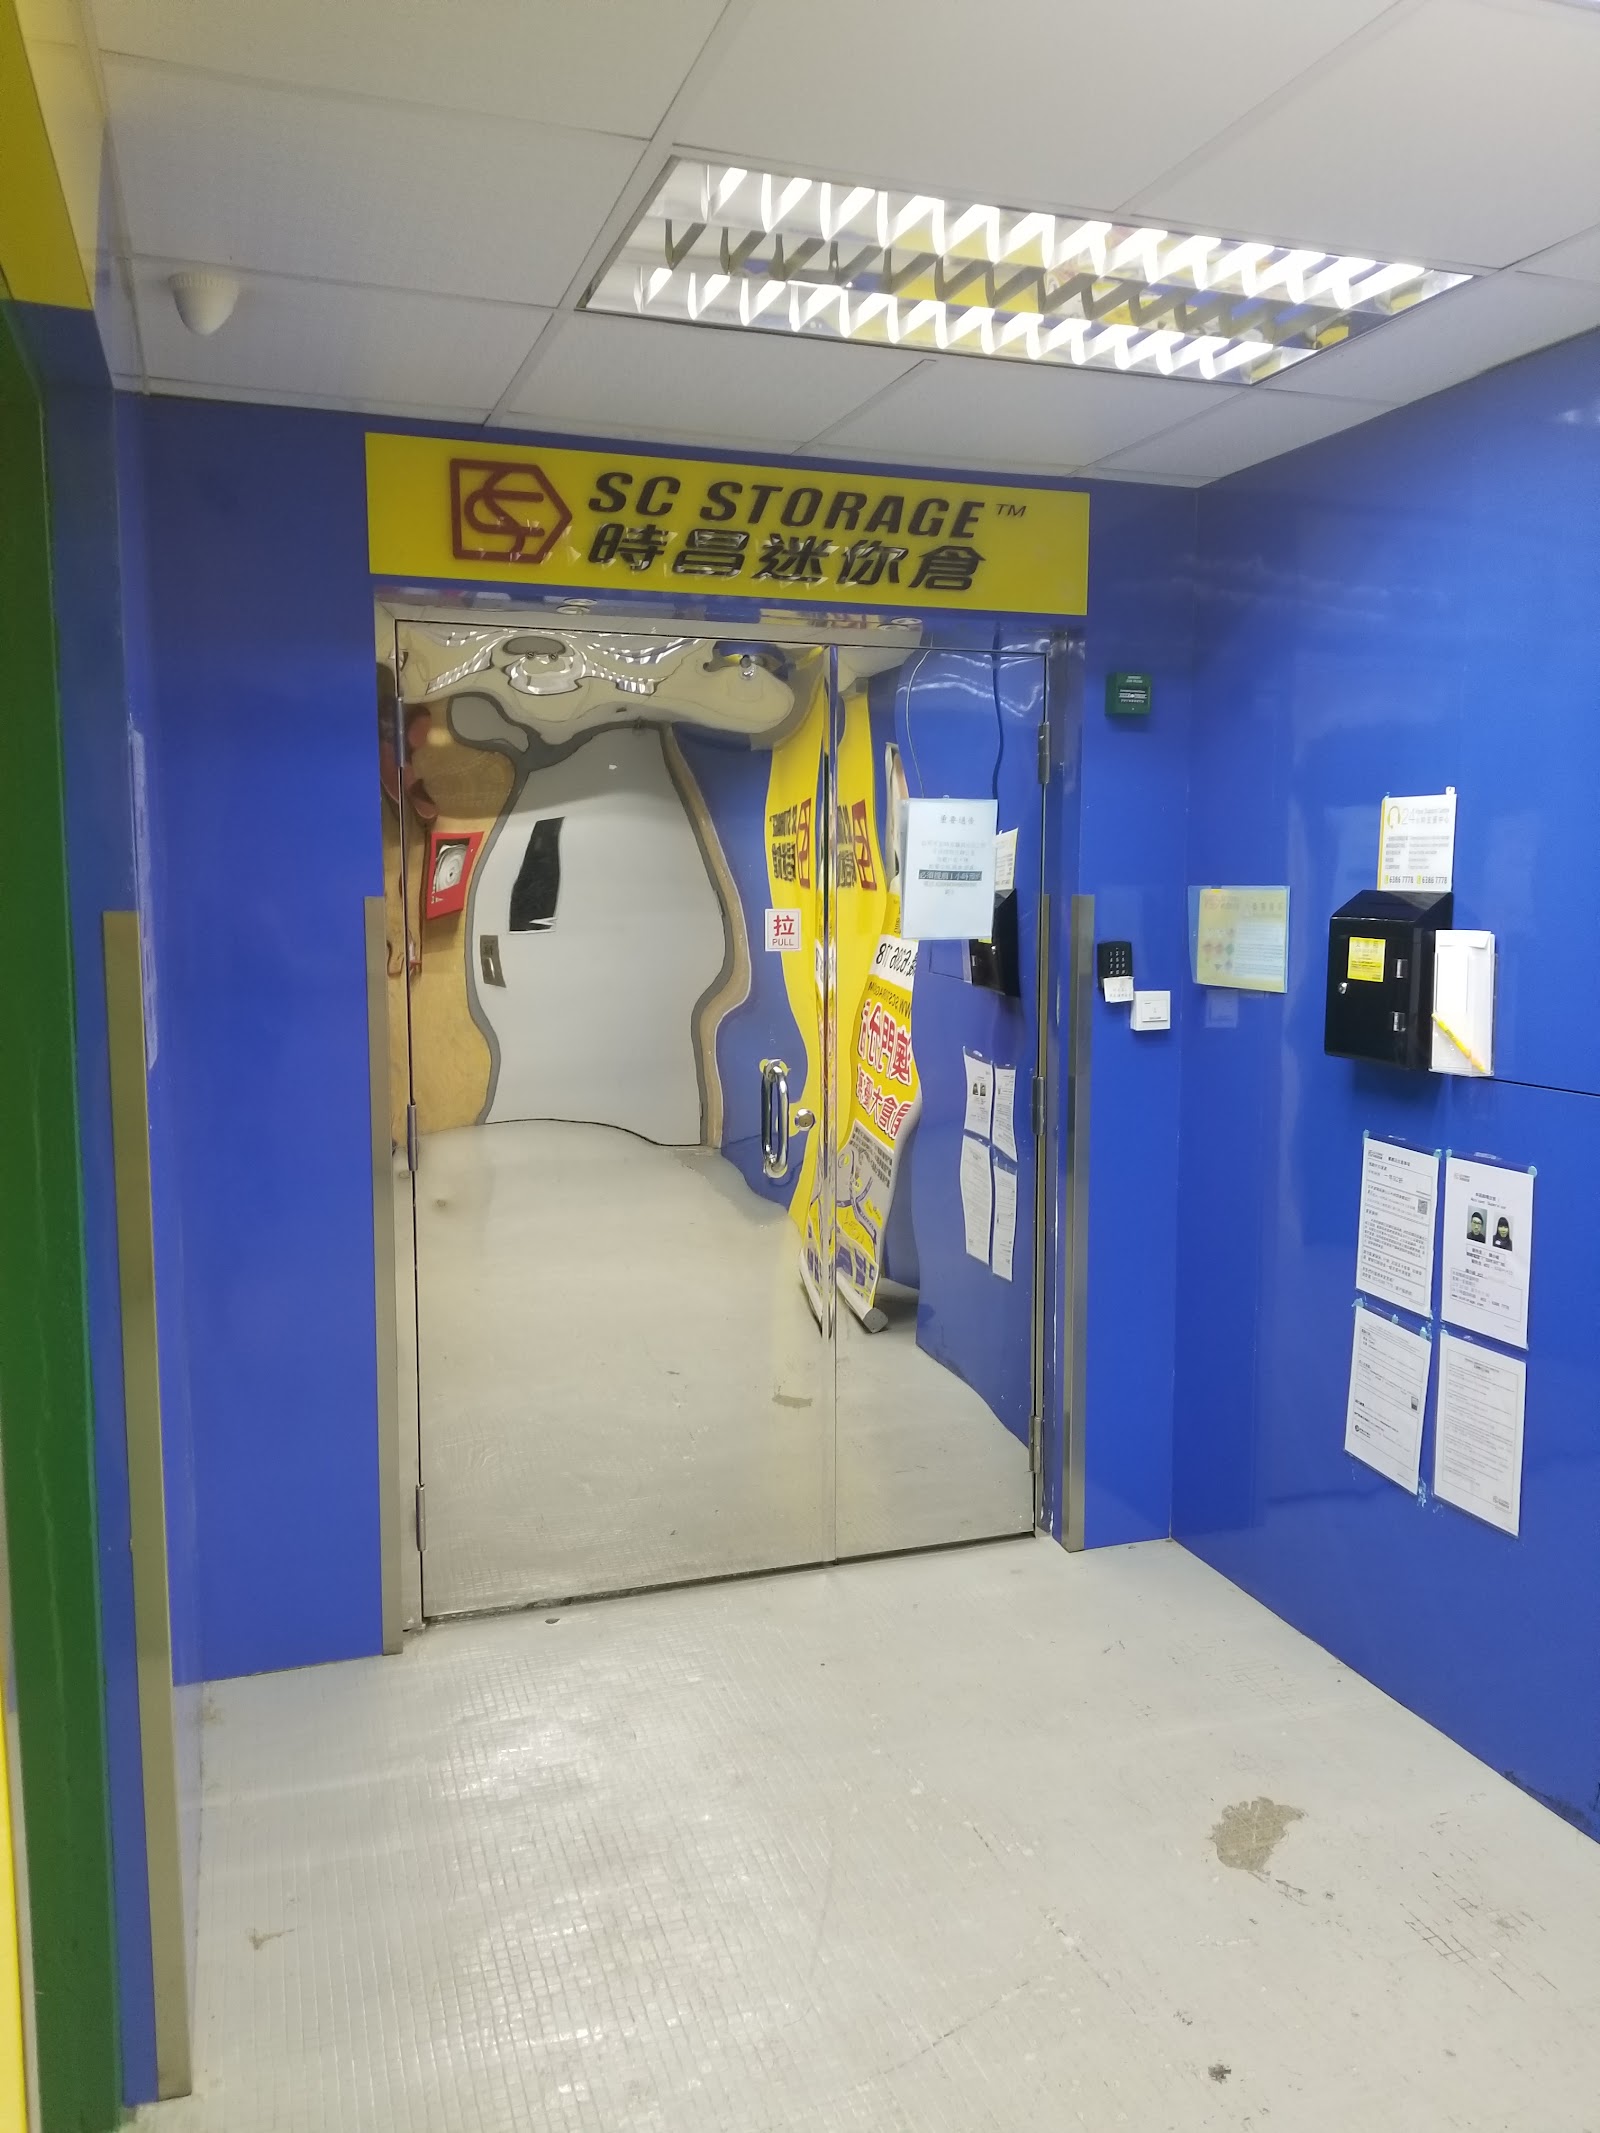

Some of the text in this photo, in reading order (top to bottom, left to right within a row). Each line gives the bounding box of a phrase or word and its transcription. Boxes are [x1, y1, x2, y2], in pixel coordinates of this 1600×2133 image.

[588, 471, 681, 517] SC
[700, 480, 985, 539] STORAGE
[588, 523, 987, 590] 時昌迷你倉
[772, 938, 794, 947] PULL
[773, 915, 795, 937] 拉
